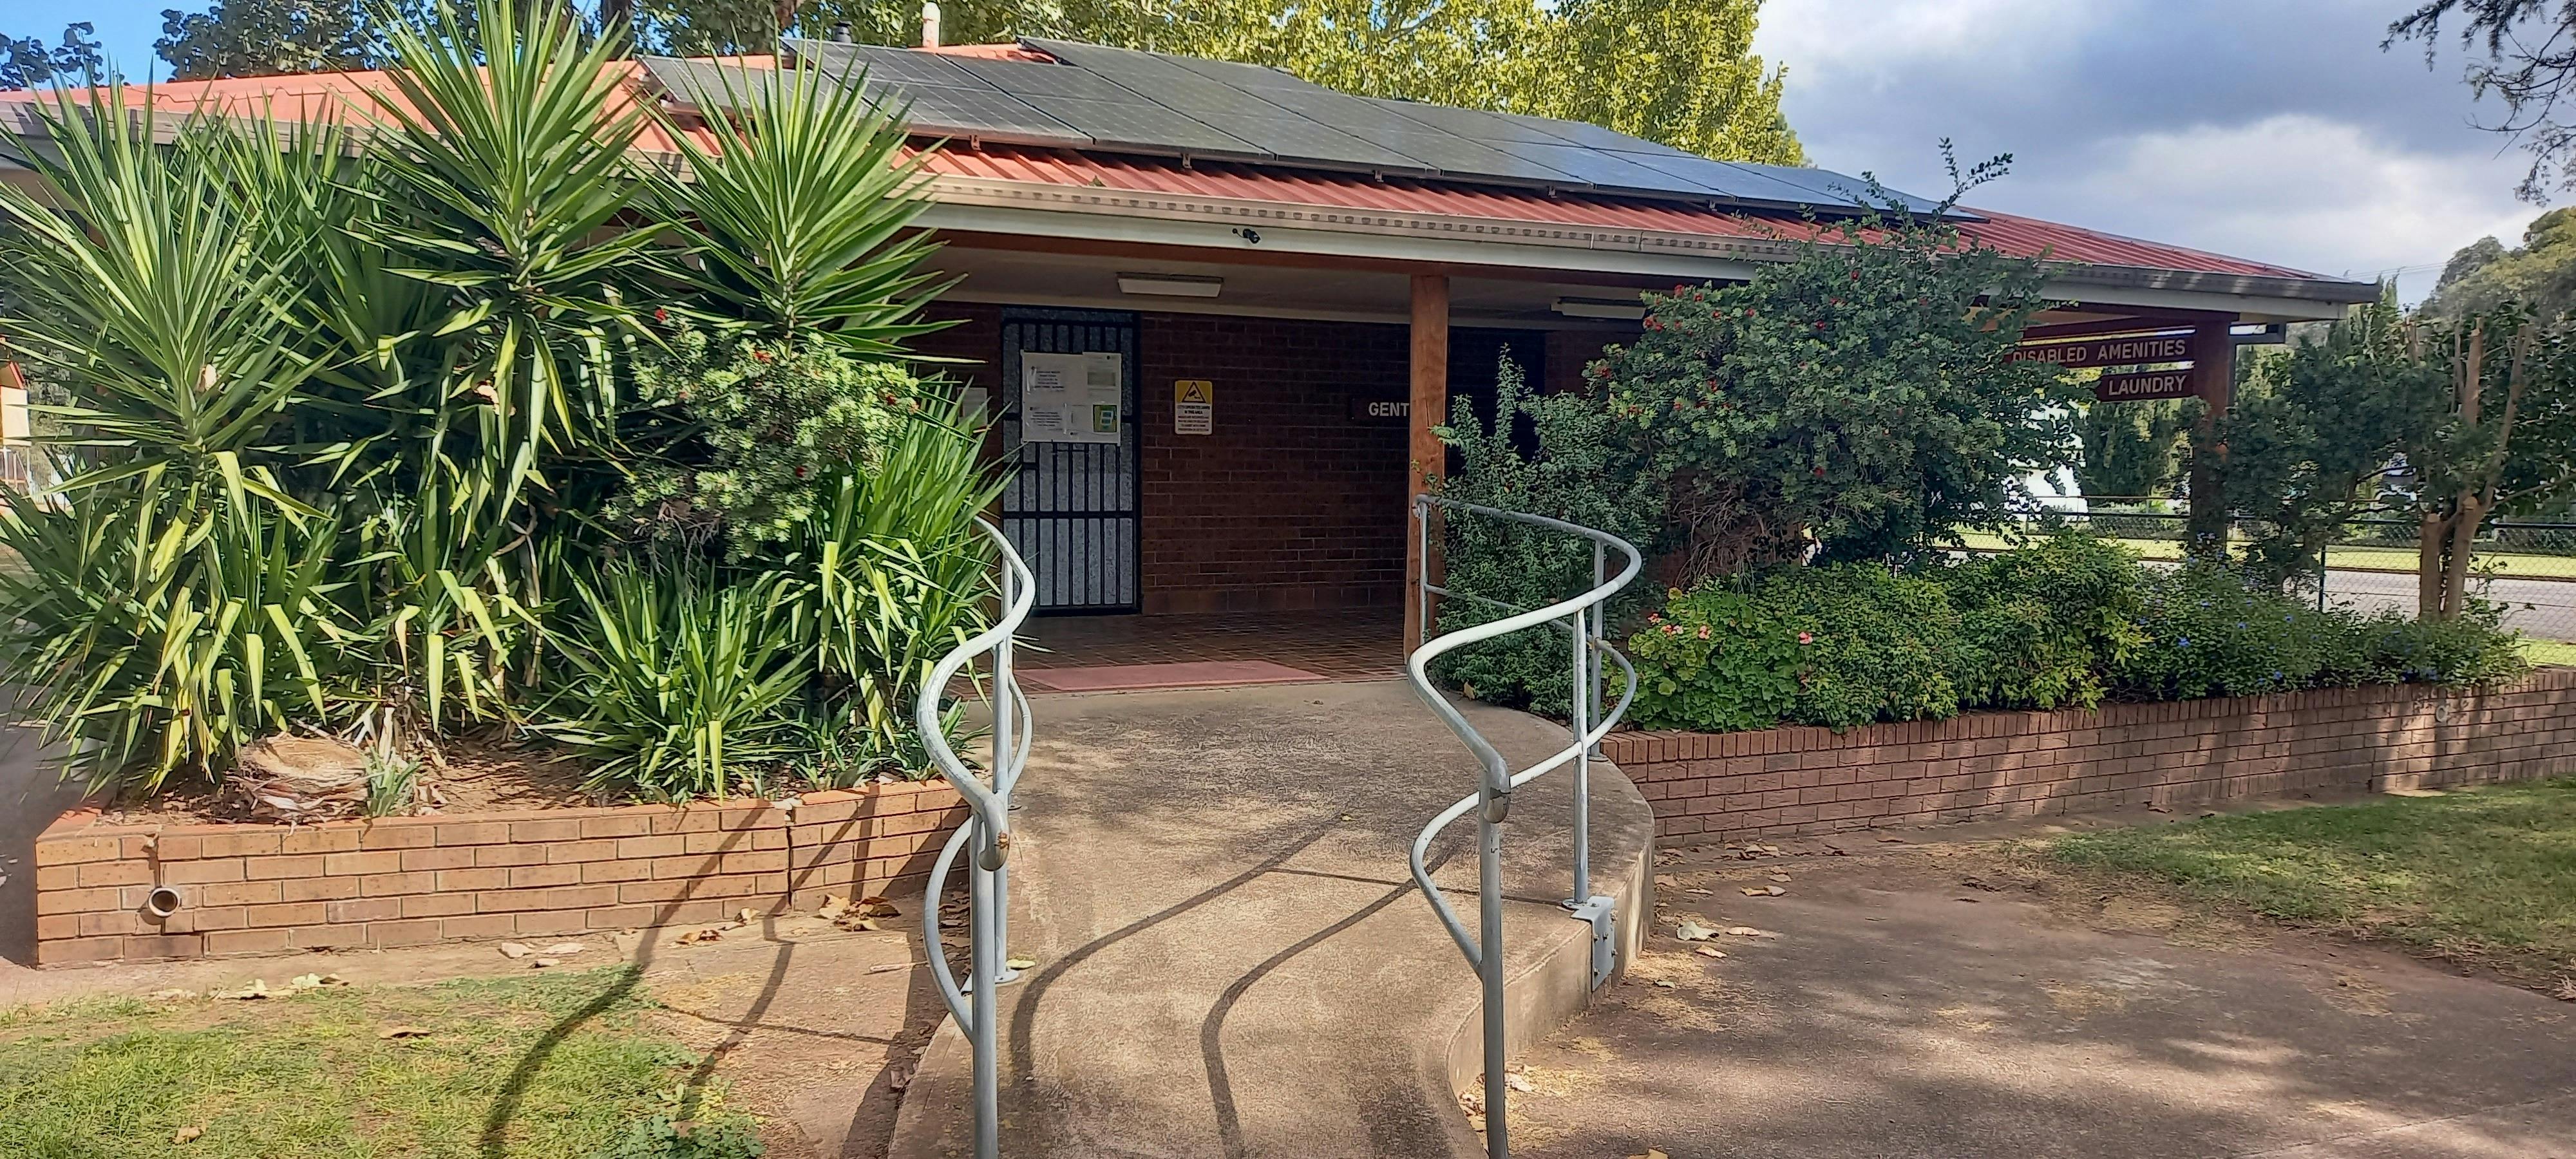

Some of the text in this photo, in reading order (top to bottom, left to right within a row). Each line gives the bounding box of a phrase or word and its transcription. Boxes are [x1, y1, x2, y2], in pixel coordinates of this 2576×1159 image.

[2012, 339, 2186, 363] DISABLED AMENITIES
[2108, 375, 2187, 396] LAUNDRY
